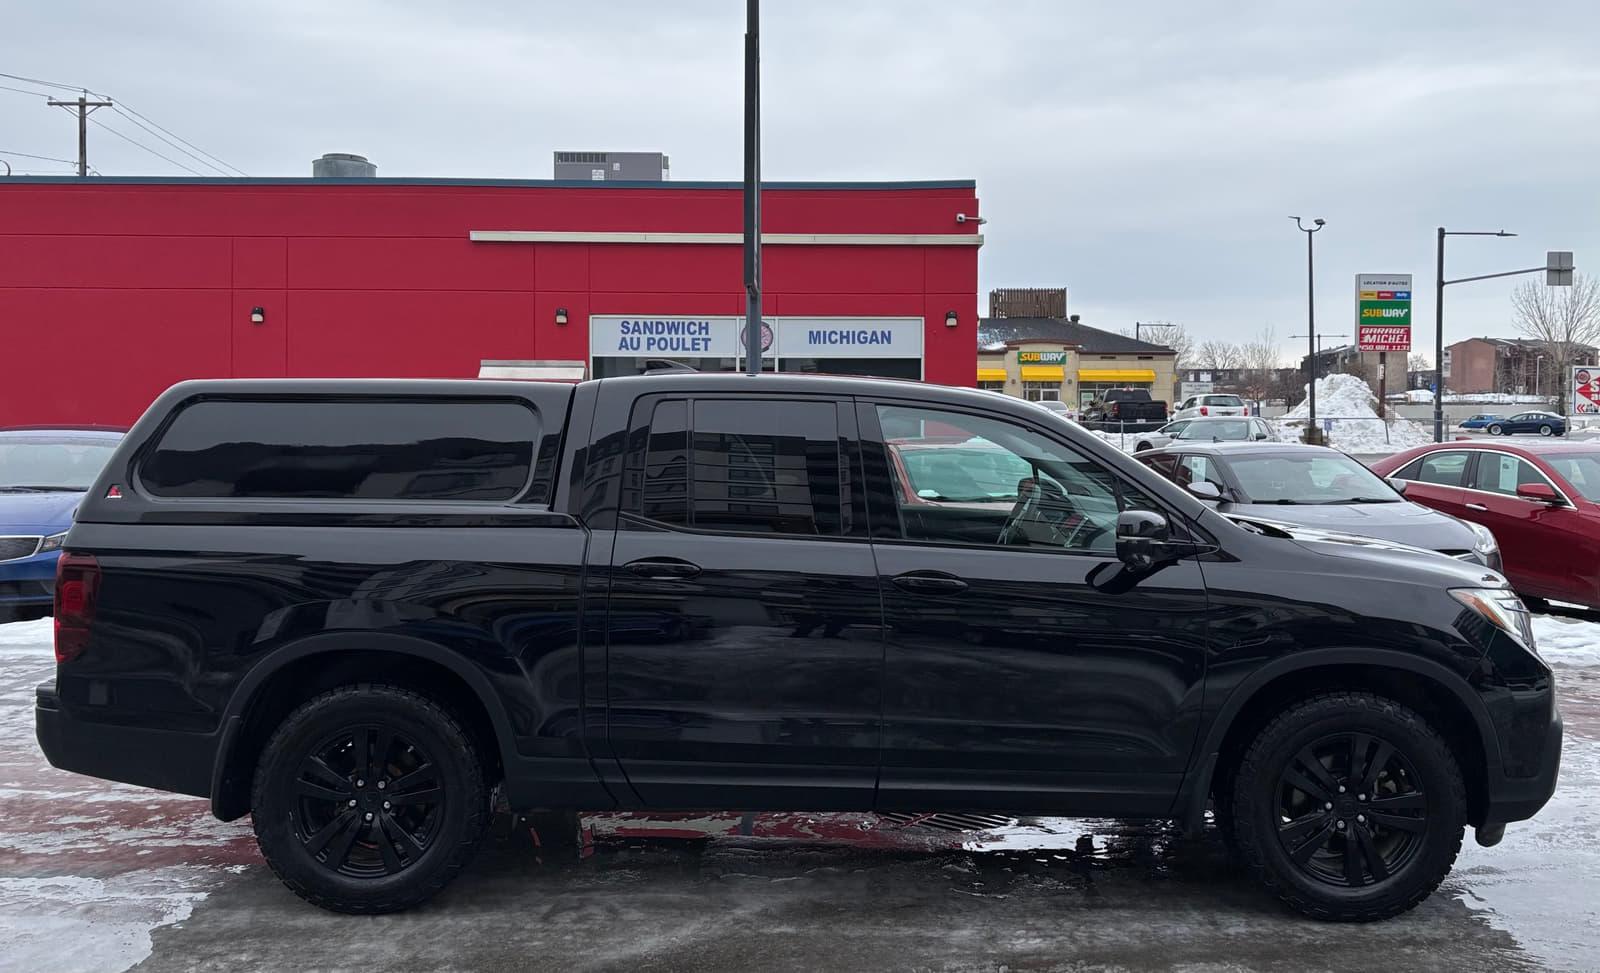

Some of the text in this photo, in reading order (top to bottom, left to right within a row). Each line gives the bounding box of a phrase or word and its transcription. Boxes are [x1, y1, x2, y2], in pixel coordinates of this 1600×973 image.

[1362, 308, 1409, 318] SUBWAY
[620, 320, 710, 336] SANDWICH
[1361, 327, 1409, 335] GARAGE
[808, 330, 892, 345] MICHIGAN
[1361, 334, 1409, 344] MICHEL
[618, 337, 712, 352] AU POULET
[1020, 352, 1066, 362] SUBWAY
